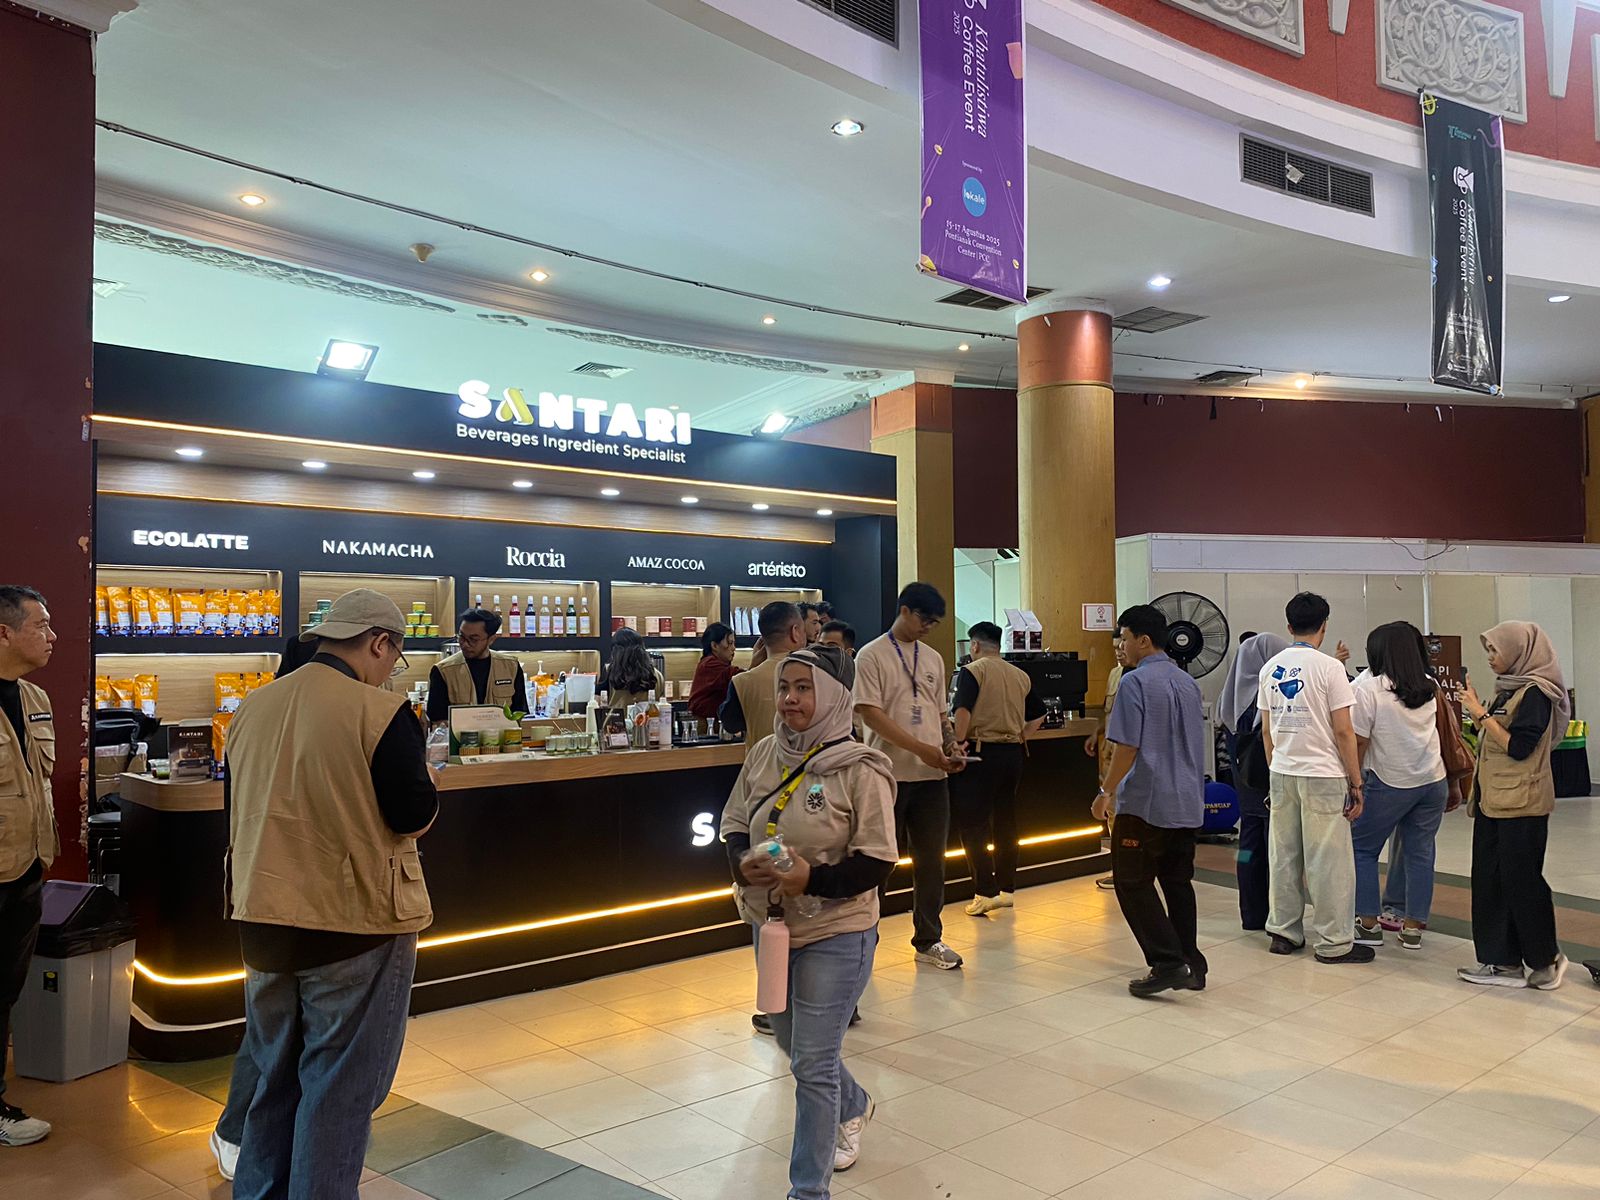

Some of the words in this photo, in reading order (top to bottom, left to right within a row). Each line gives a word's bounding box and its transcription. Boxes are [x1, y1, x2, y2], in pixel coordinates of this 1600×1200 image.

[953, 10, 961, 36] 2025
[962, 15, 975, 76] Coffee
[975, 22, 990, 138] Khatulistiwa
[963, 79, 976, 132] Event
[963, 188, 985, 205] lokale
[946, 220, 960, 233] 15-17
[961, 225, 985, 240] Agustus
[986, 235, 1000, 247] 2025
[1458, 199, 1467, 243] Coffee
[944, 229, 972, 246] Pontianak
[972, 239, 1002, 256] Convention
[957, 246, 976, 258] Center
[1459, 247, 1468, 281] Event
[457, 379, 692, 446] SANTARI
[456, 423, 539, 447] Beverages
[543, 434, 619, 456] Ingredient
[623, 444, 687, 464] Specialist
[132, 529, 249, 550] ECOLATTE
[322, 539, 434, 559] NAKAMACHA
[506, 546, 566, 568] Roccia
[627, 556, 663, 570] AMAZ
[664, 558, 705, 571] COCOA
[747, 560, 806, 578] artéristo
